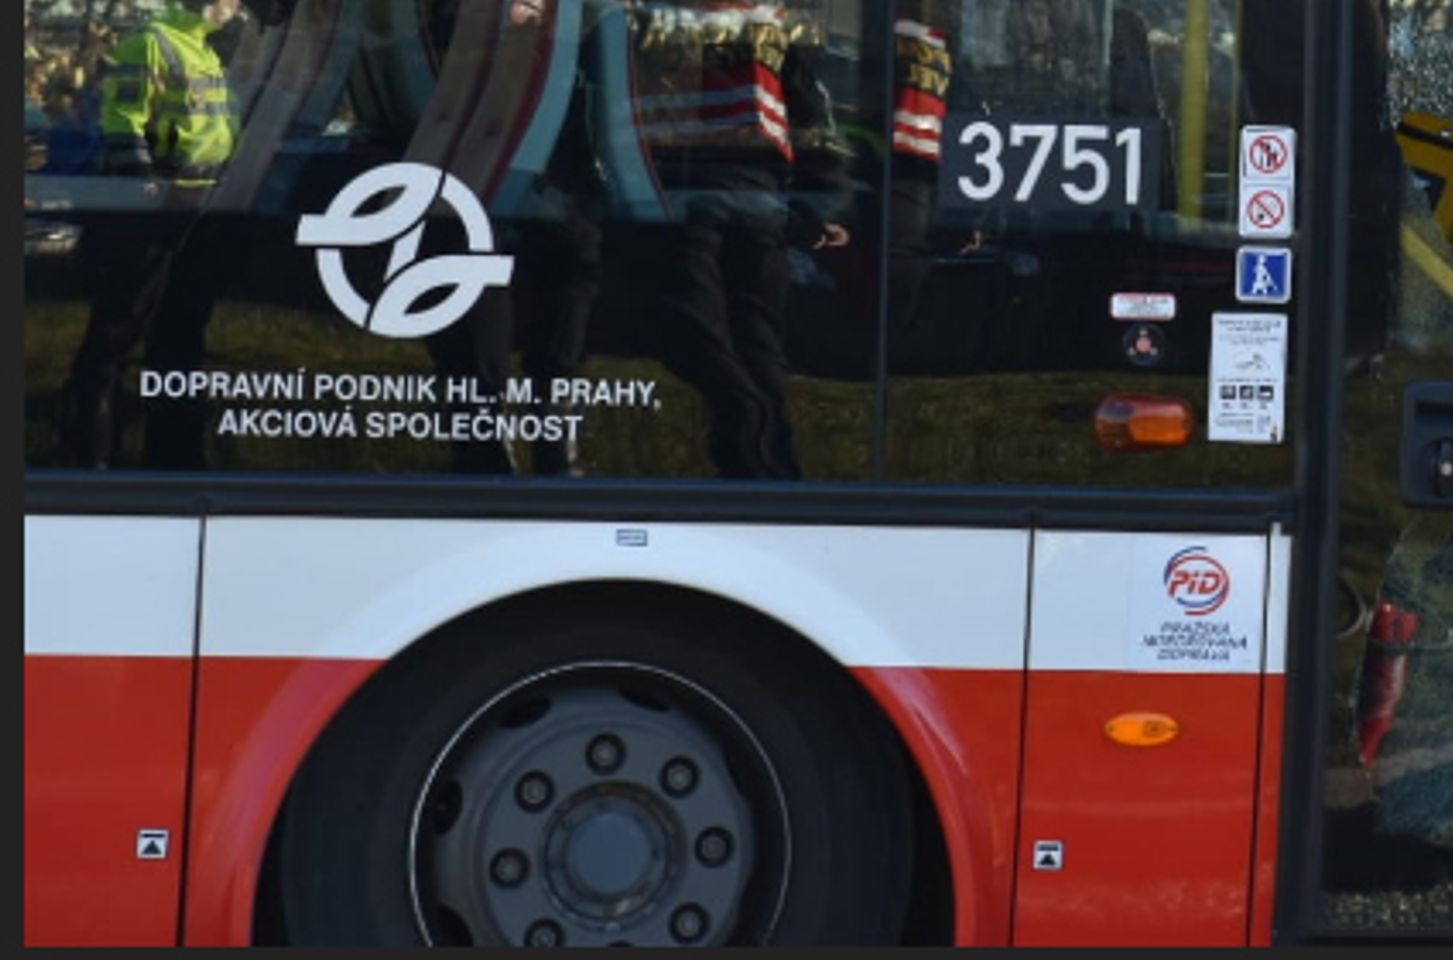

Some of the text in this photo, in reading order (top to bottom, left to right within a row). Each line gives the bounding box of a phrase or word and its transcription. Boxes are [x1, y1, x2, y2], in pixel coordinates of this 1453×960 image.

[957, 120, 1141, 205] 3751
[140, 367, 661, 409] DOPRAVNÍ PODNIK HL. M. PRAHY,
[218, 406, 583, 442] AKCIOVÁ SPOLEČNOST
